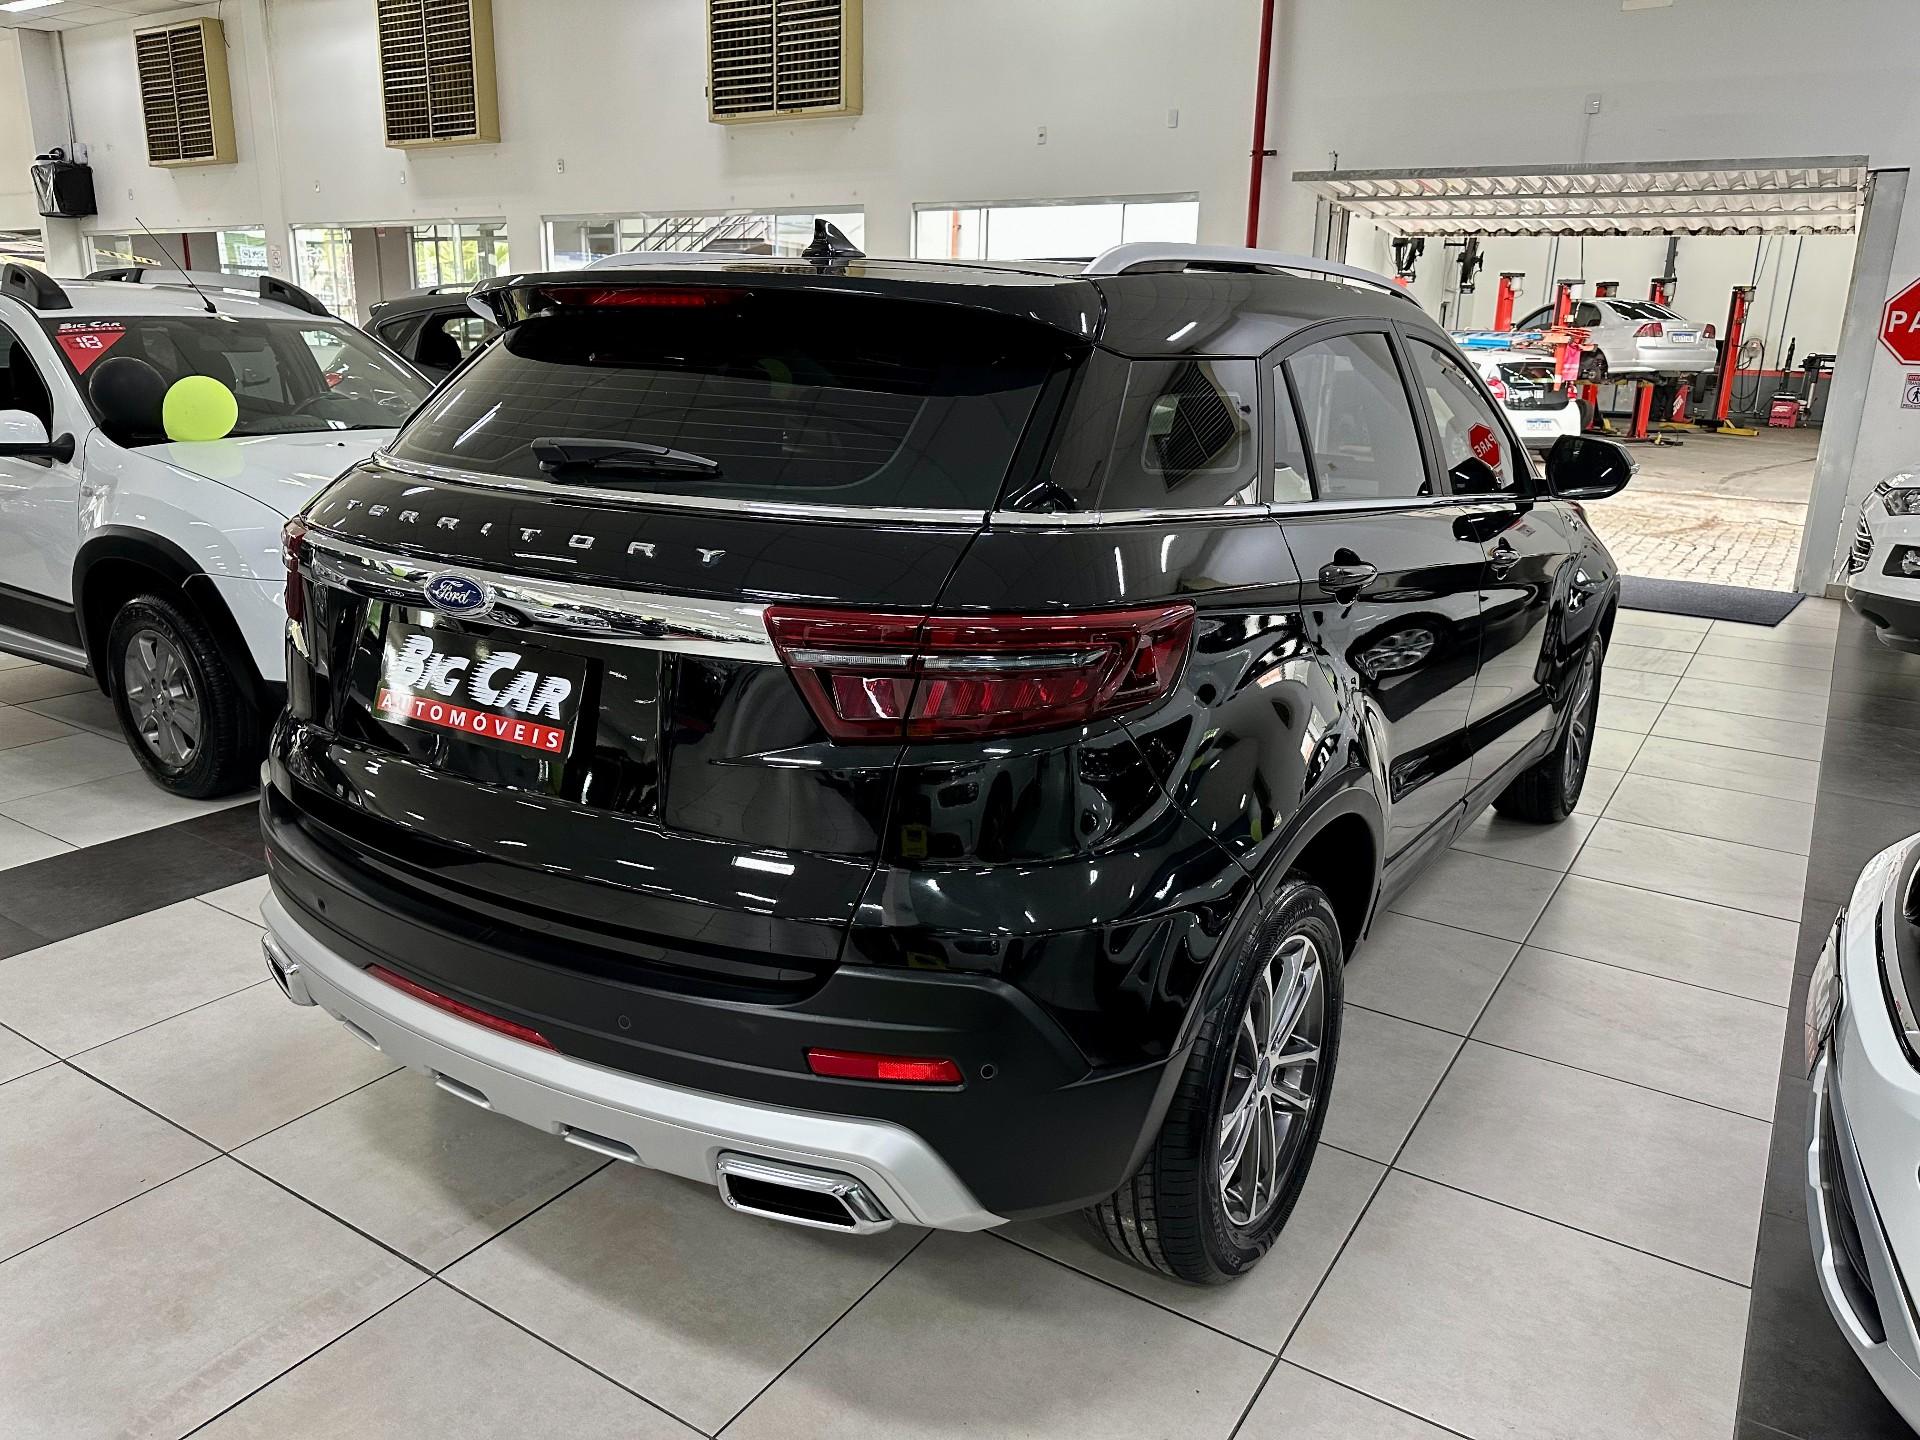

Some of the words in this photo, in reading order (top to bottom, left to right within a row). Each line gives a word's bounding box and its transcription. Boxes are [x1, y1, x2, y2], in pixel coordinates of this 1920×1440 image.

[346, 499, 726, 564] TERRITORY
[431, 580, 478, 605] Ford
[388, 634, 471, 697] BIG
[467, 651, 572, 720] CAR
